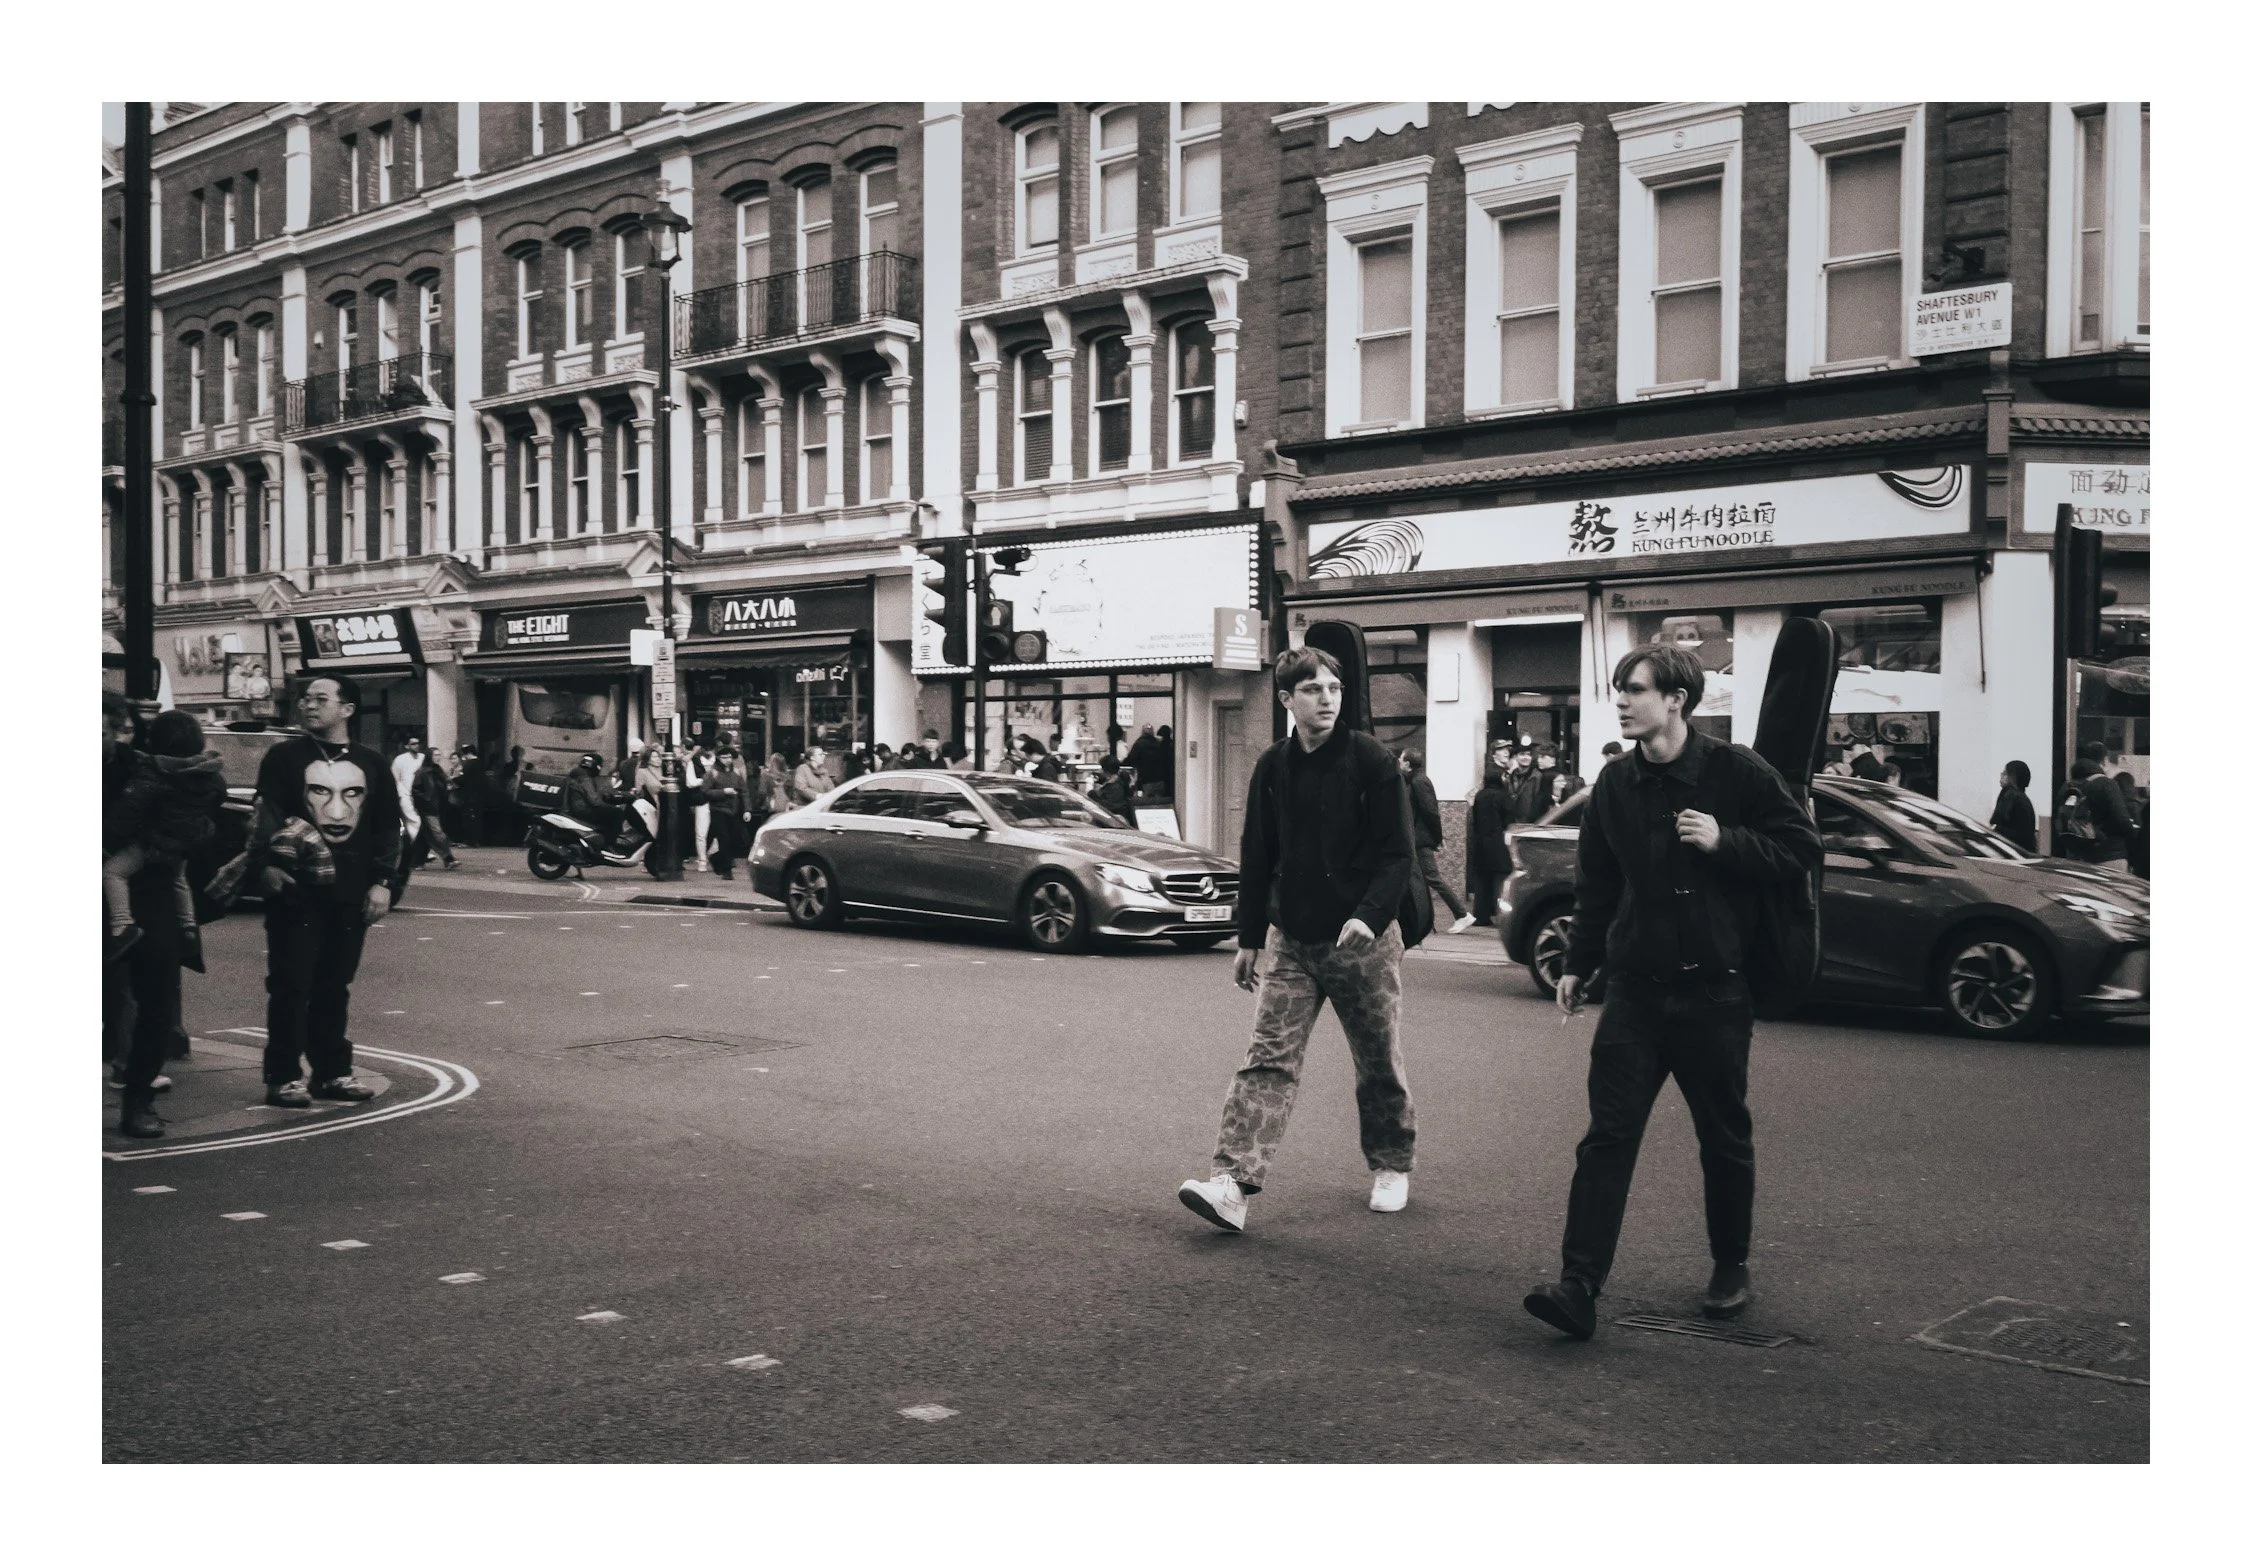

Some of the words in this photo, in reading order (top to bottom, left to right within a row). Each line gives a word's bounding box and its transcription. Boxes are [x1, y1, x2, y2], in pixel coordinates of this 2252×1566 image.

[1917, 290, 1998, 312] SHAFTESBURY
[1916, 309, 1960, 326] AVENUE
[1632, 502, 1776, 535] 兰州牛肉拉面
[1632, 537, 1674, 553] KUNG
[1680, 535, 1699, 548] FU
[1704, 530, 1774, 547] NOODLE
[507, 619, 526, 634] THE
[526, 614, 570, 635] EIGHT
